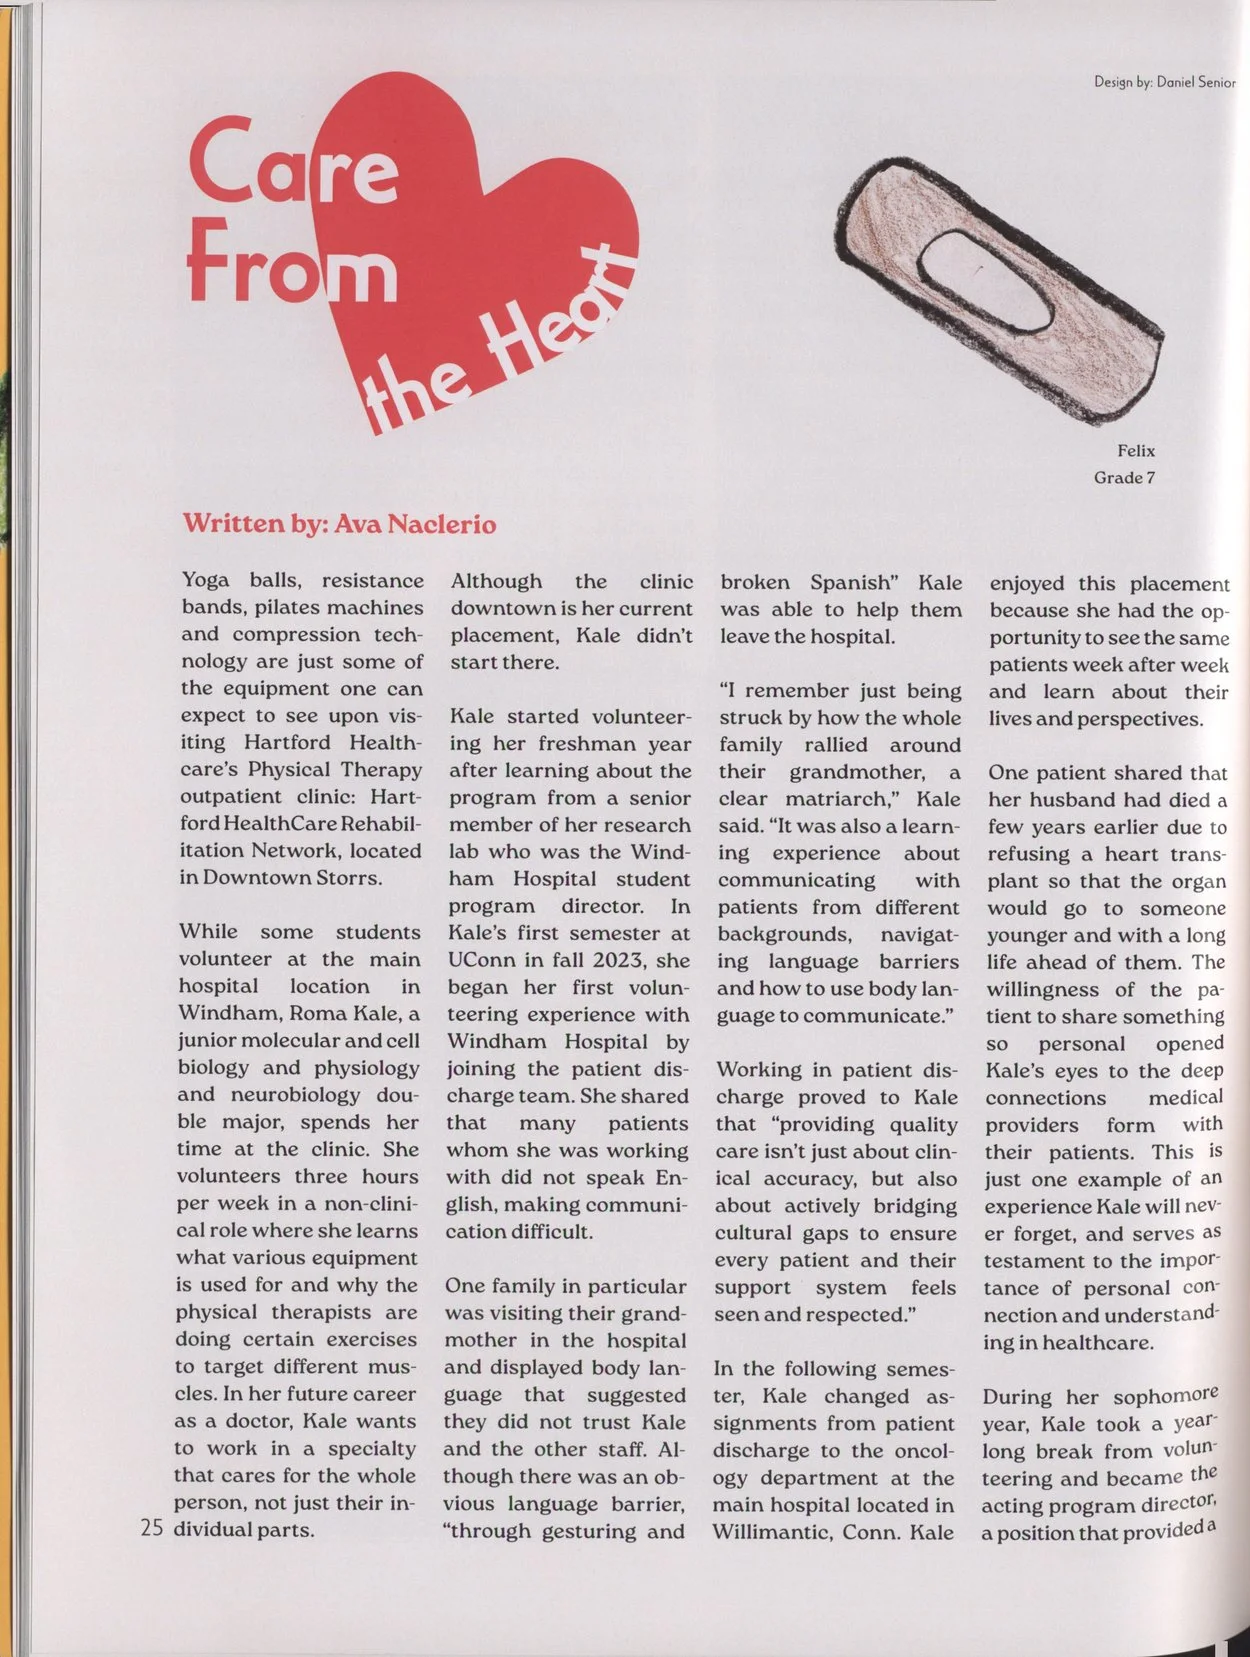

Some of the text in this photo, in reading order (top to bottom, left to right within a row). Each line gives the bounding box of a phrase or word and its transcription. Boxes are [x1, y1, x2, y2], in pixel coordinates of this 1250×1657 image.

[1095, 75, 1236, 91] Design by: Daniel Senior
[189, 115, 399, 204] Care
[187, 216, 397, 303] From
[362, 242, 639, 434] the Heart
[1118, 444, 1155, 457] Felix
[1095, 471, 1155, 484] Grade 7
[183, 512, 496, 538] Written by: Ava Naclerio
[182, 571, 424, 591] Yoga balls, resistance
[451, 573, 693, 593] Although the clinic
[721, 574, 790, 590] broken
[919, 575, 962, 590] Kale
[990, 575, 1230, 595] enjoyed this placement
[451, 708, 692, 724] Kale started volunteer-
[990, 710, 1203, 730] lives and perspectives.
[249, 761, 330, 781] Physical
[341, 761, 423, 781] Therapy
[719, 790, 768, 806] clear
[917, 791, 960, 807] Kale
[987, 900, 1226, 920] would go to someone
[718, 925, 959, 946] backgrounds, navigat-
[449, 951, 690, 970] UConn in fall 2023, she
[178, 1004, 420, 1023] Windham, Roma Kale, a
[717, 1088, 958, 1108] charge proved to Kale
[986, 1088, 1223, 1105] connections medical
[447, 1114, 688, 1135] that many patients
[715, 1279, 956, 1299] support system feels
[984, 1280, 1220, 1300] tance of personal con-
[176, 1331, 417, 1351] doing certain exercises
[983, 1387, 1218, 1409] During her sophomore
[141, 1518, 163, 1536] 25
[174, 1521, 314, 1541] dividual parts.
[543, 1523, 637, 1543] gesturing
[648, 1523, 685, 1539] and
[712, 1524, 954, 1542] Willimantic, Conn. Kale
